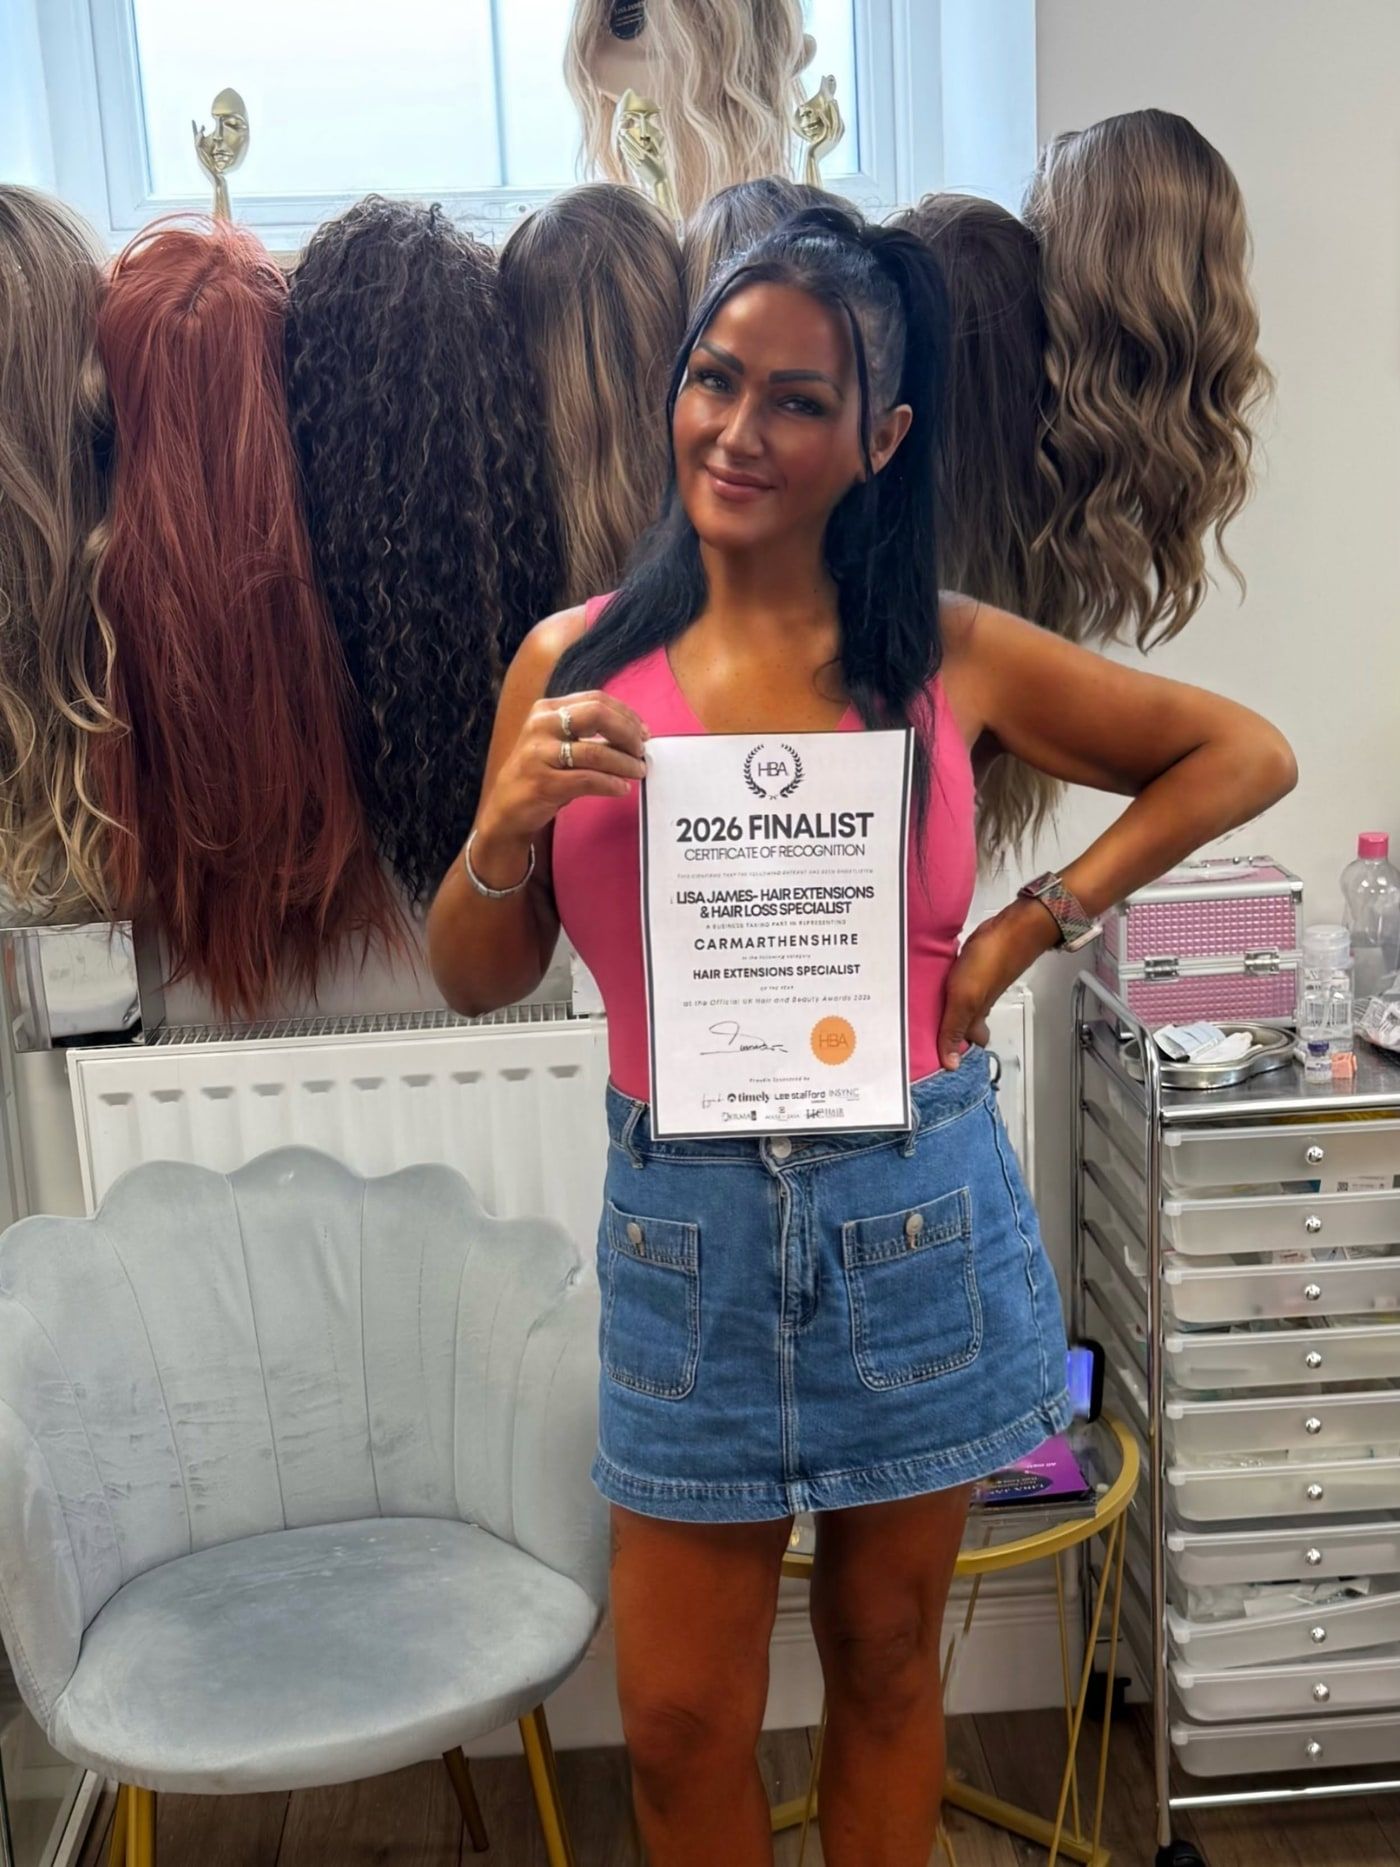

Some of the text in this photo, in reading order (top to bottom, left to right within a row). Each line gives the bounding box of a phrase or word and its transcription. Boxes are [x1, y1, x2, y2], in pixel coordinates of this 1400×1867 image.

[758, 762, 788, 777] HBA
[676, 812, 874, 842] 2026 FINALIST
[684, 844, 865, 861] CERTIFICATE OF RECOGNITION
[676, 885, 875, 904] LISA JAMES- HAIR EXTENSIONS
[700, 900, 852, 919] & HAIR LOSS SPECIALIST
[694, 933, 859, 951] CARMARTHENSHIRE
[693, 964, 861, 980] HAIR EXTENSIONS SPECIALIST
[819, 1033, 848, 1049] HBA
[738, 1091, 770, 1103] timely
